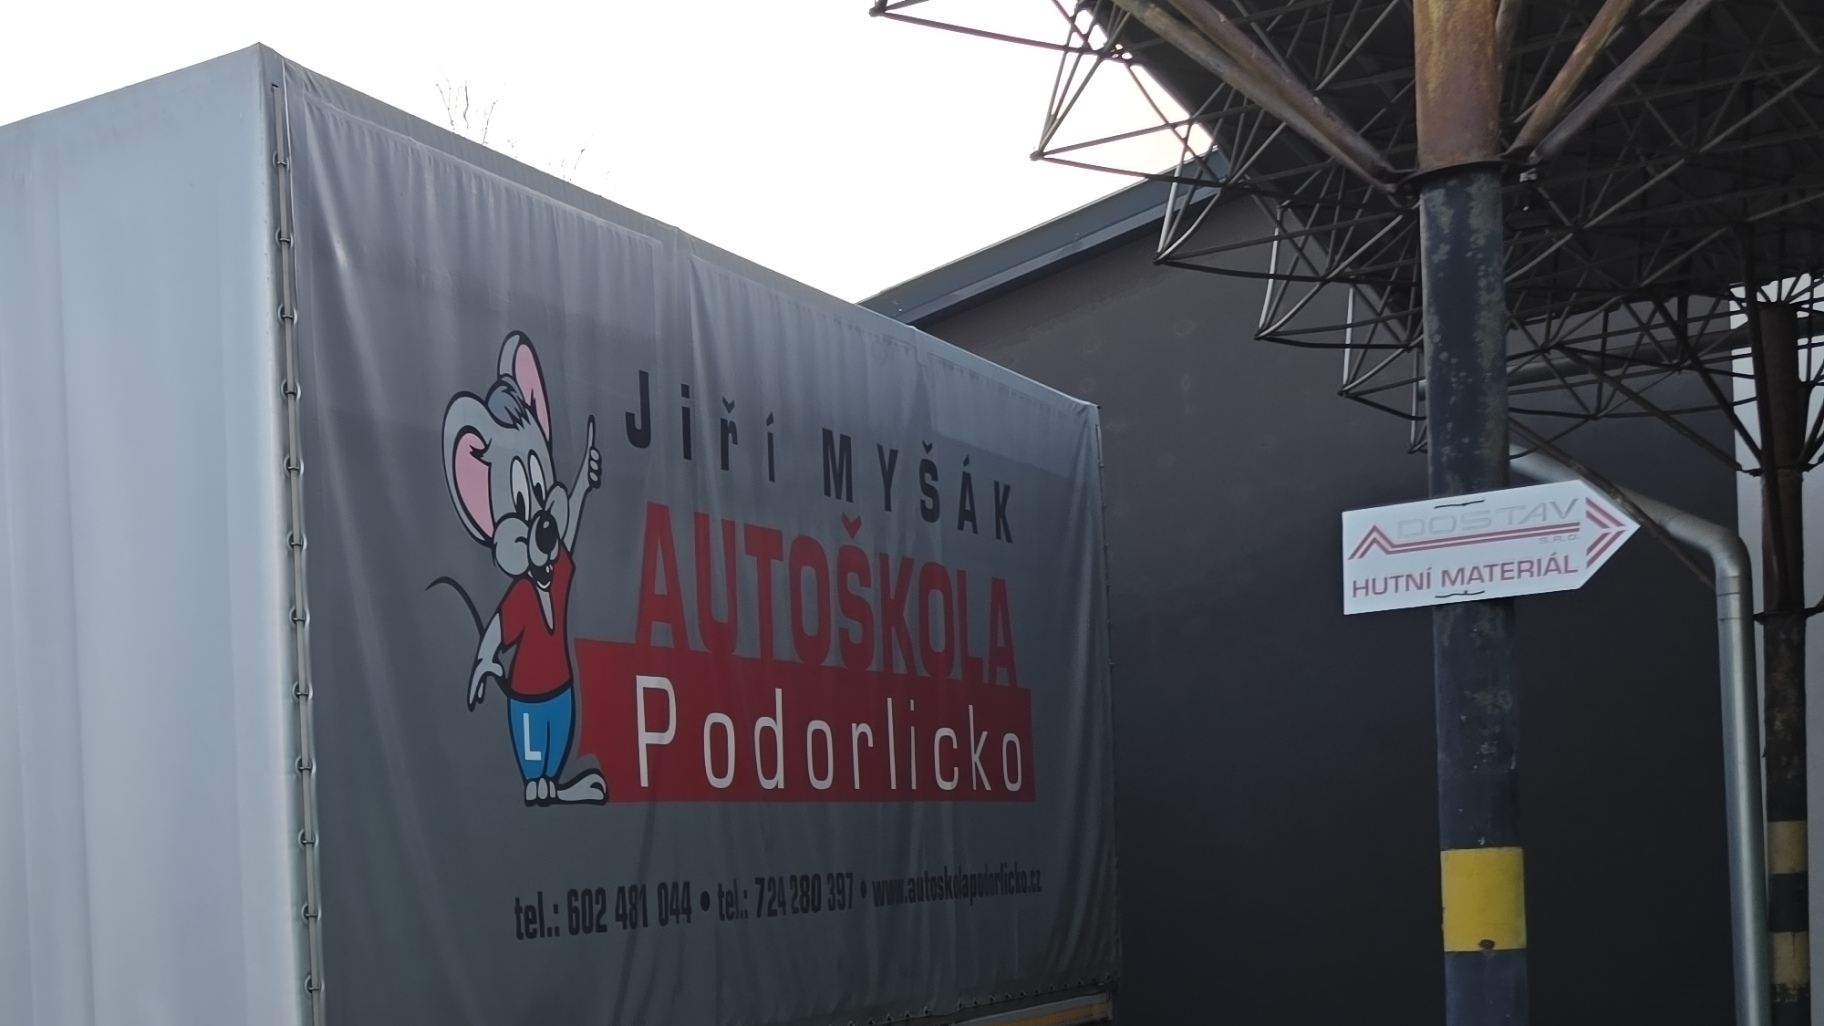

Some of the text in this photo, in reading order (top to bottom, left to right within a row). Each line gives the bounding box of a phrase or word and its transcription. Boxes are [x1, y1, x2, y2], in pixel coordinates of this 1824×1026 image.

[625, 370, 1014, 544] Jiří MYŠÁK
[635, 501, 1019, 688] AUTOŠKOLA
[1352, 552, 1578, 598] HUTNÍ MATERIÁL
[523, 712, 542, 761] L
[636, 675, 1023, 793] Podorlicko
[514, 862, 1042, 940] tel.: 602 481 044 tel.: 724 280 397 www.autoskolapodorlicko.cz
